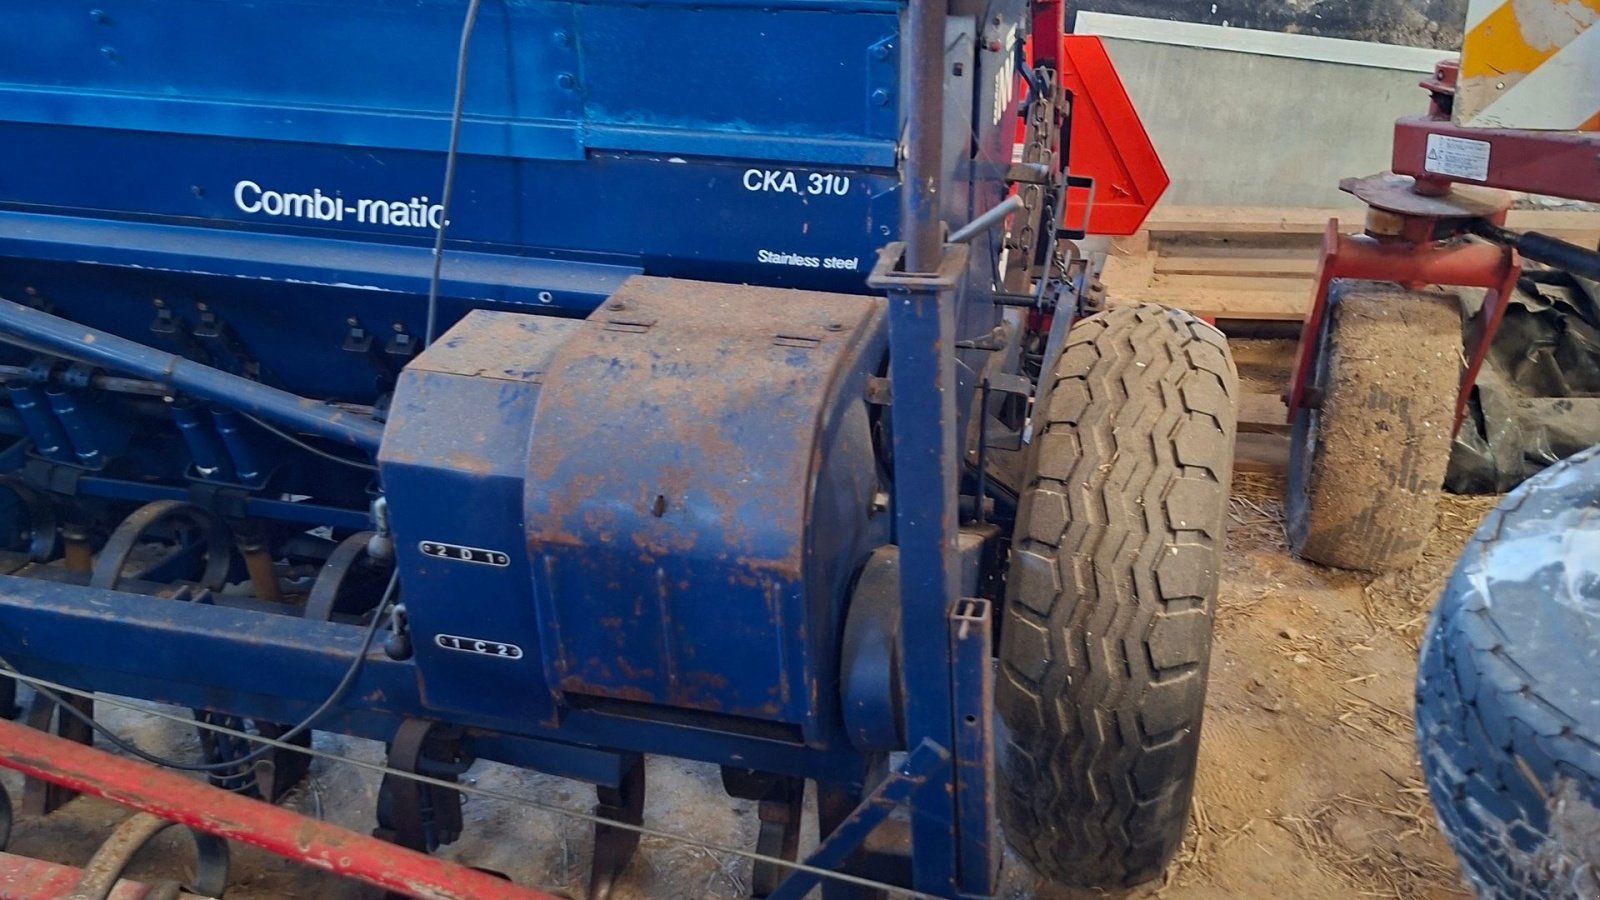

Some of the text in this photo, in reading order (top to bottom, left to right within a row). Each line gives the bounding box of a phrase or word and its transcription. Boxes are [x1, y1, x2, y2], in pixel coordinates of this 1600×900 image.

[743, 169, 850, 196] CKA 310
[234, 180, 450, 229] Combi-matic
[757, 249, 859, 270] Stainless steel
[437, 545, 495, 563] 2 D 1
[452, 638, 508, 656] 1 C 2
